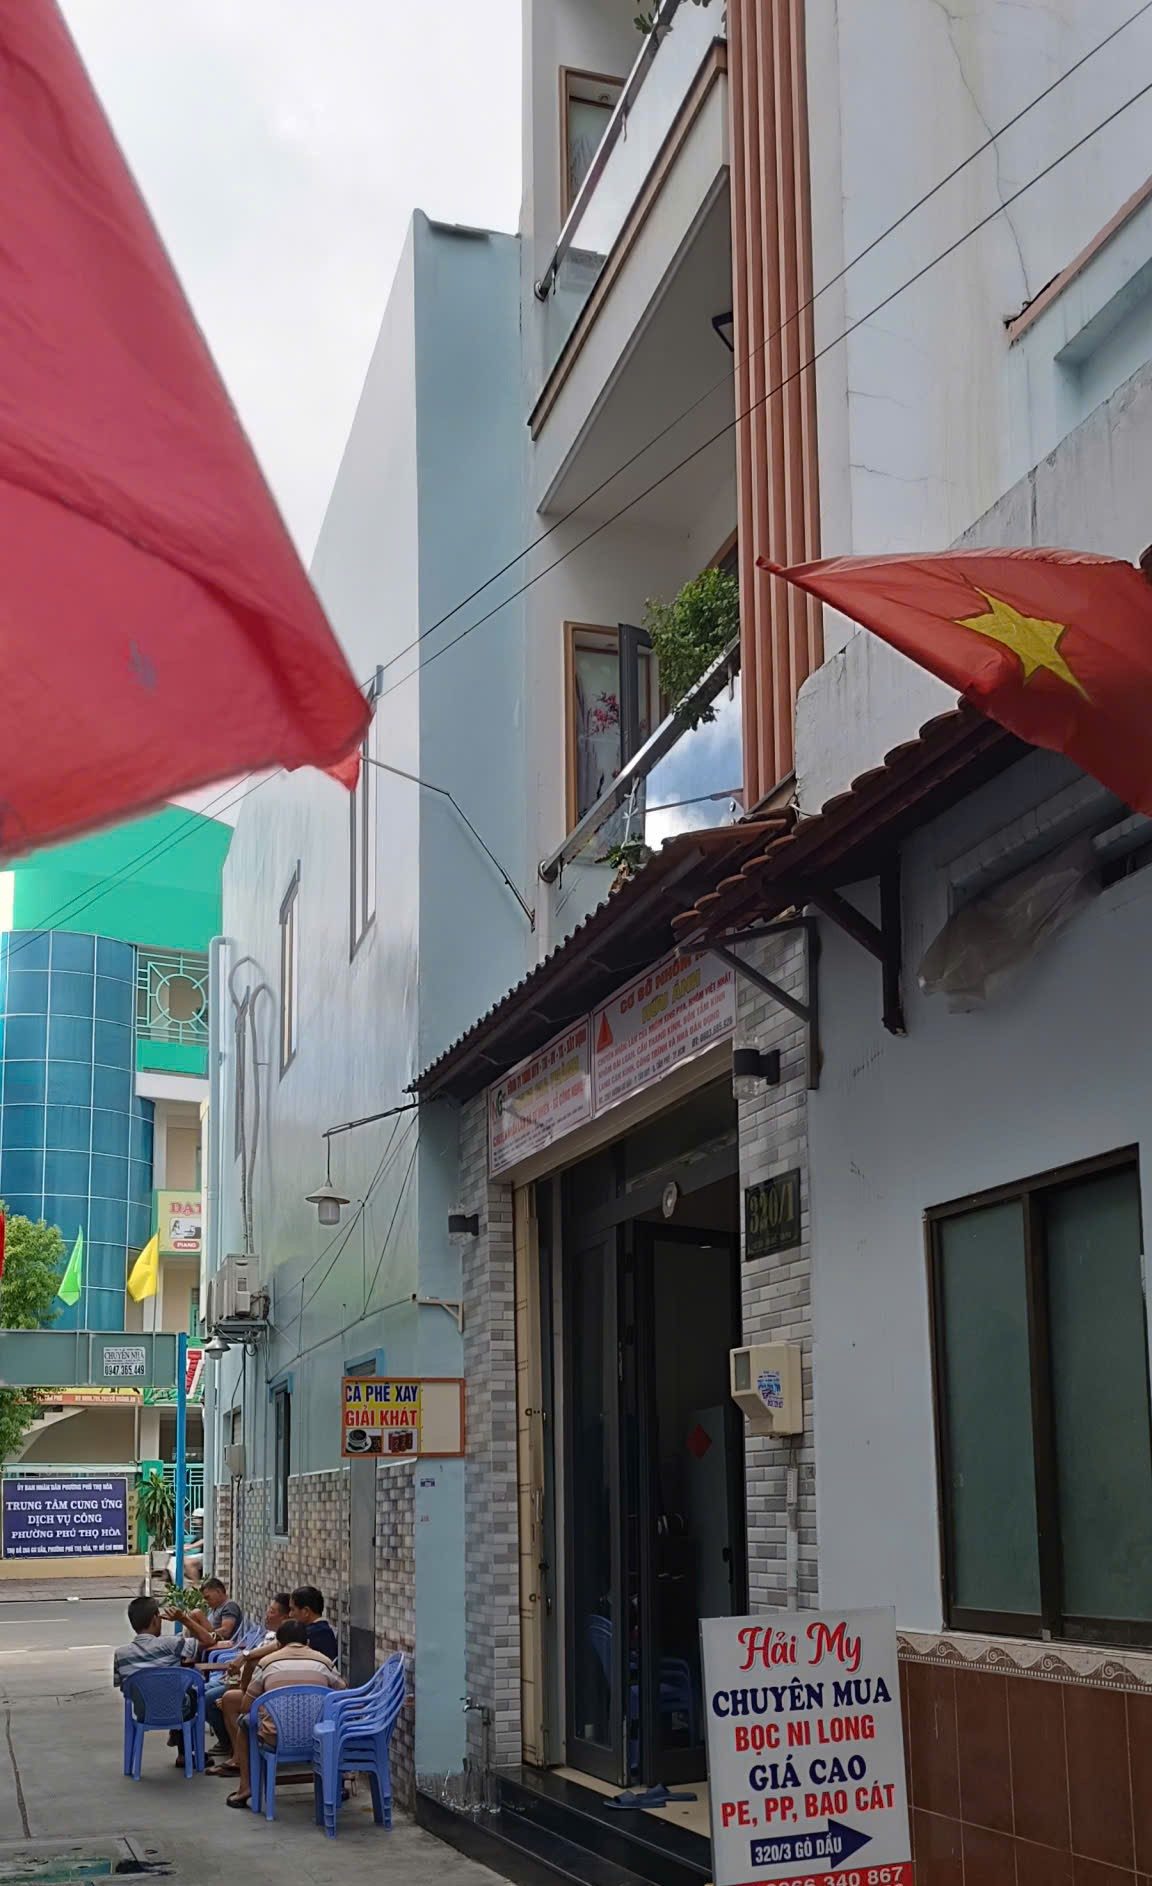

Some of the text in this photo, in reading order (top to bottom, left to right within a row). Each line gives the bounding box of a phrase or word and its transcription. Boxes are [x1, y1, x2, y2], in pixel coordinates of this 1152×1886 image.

[366, 1382, 390, 1402] PHÊ
[396, 1386, 418, 1402] XAY
[346, 1405, 418, 1426] GIẢI KHÁT
[6, 1498, 122, 1510] TRUNG TÂM CUNG ỨNG
[28, 1512, 102, 1526] DỊCH VỤ CÔNG
[12, 1527, 121, 1539] PHƯỜNG PHÚ THỌ HÒA
[738, 1622, 862, 1672] Hải My
[712, 1676, 892, 1718] CHUYÊN MUA
[735, 1714, 875, 1755] BỌC NI LONG
[749, 1754, 866, 1791] GIÁ CAO
[722, 1780, 895, 1828] PE, PP, BAO CÁT
[754, 1844, 792, 1863] 320/3
[824, 1872, 860, 1886] 340
[868, 1866, 903, 1885] 867
